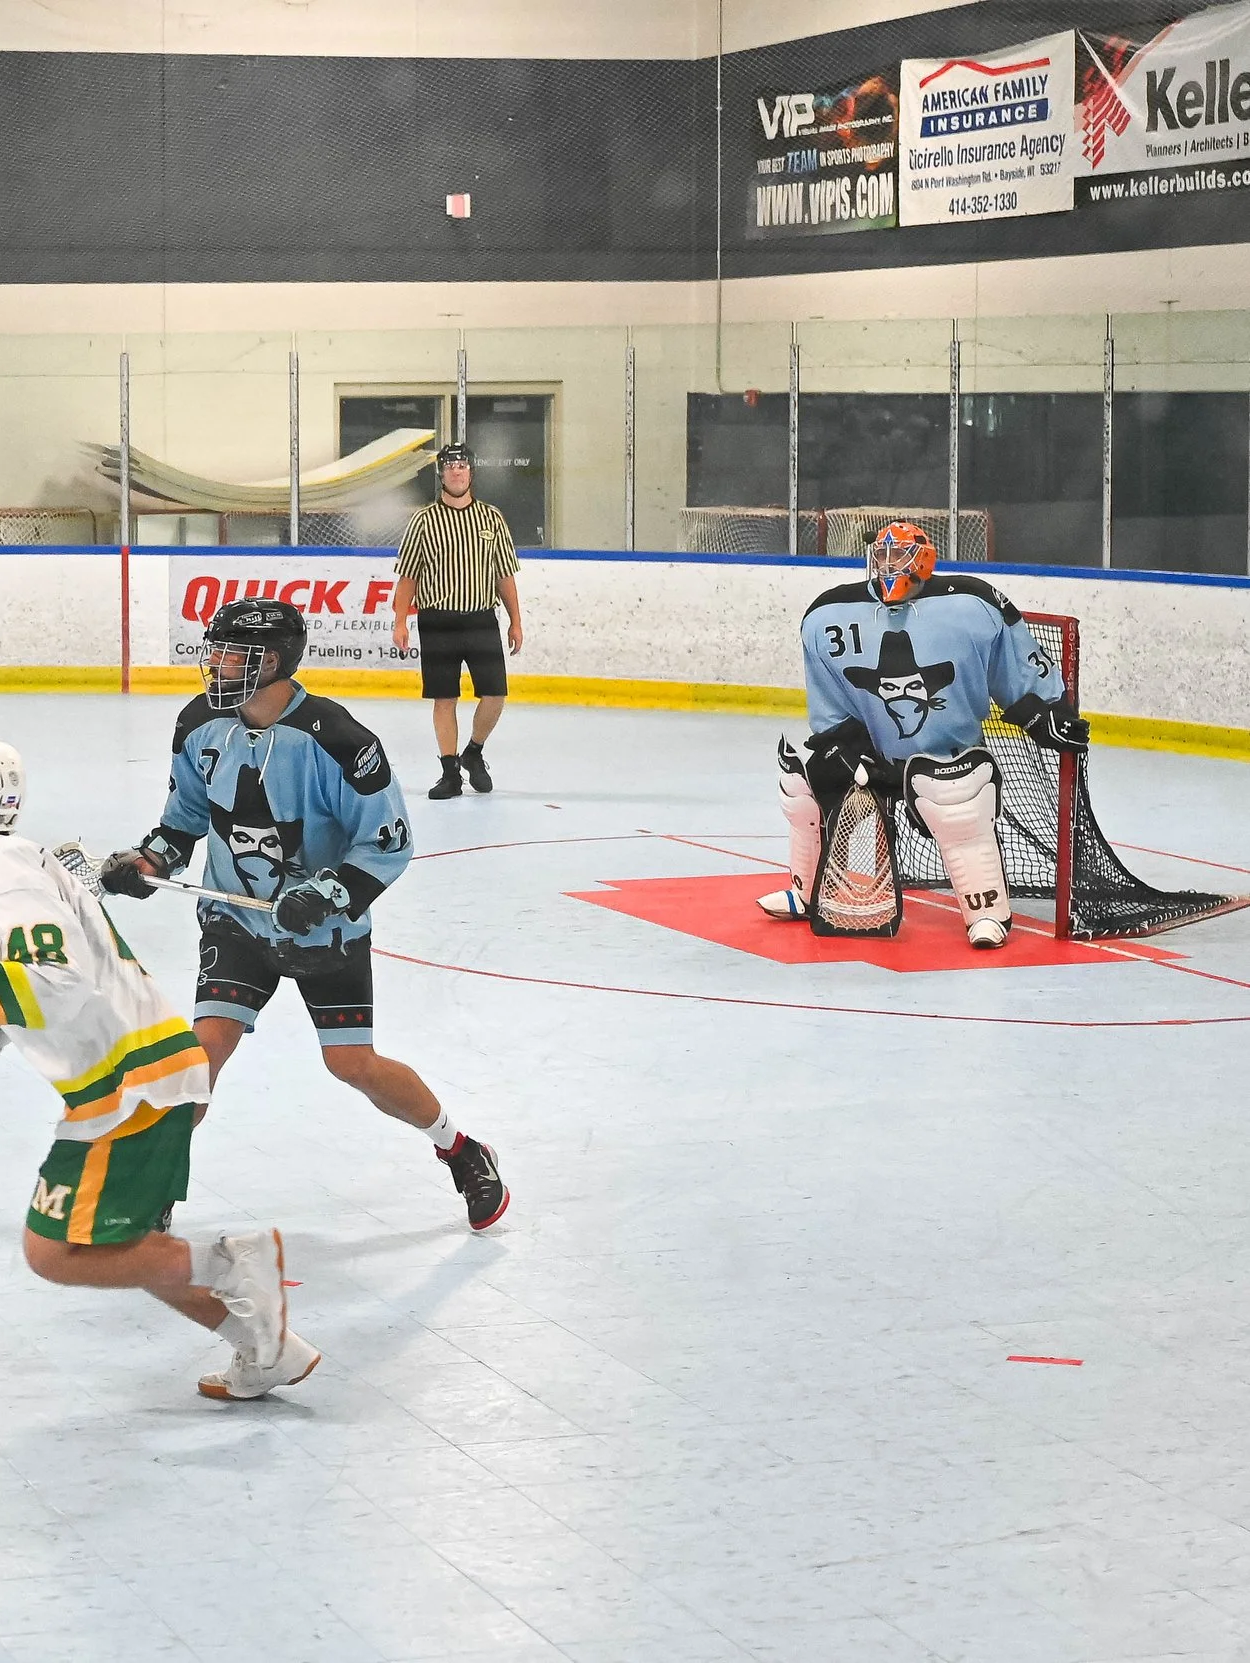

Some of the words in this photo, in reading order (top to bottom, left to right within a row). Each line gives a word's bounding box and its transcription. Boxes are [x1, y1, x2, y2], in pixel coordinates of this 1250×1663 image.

[922, 84, 988, 113] AMERICAN
[995, 74, 1048, 103] FAMILY
[757, 93, 815, 140] VIP
[930, 104, 1037, 133] INSURANCE
[787, 147, 818, 173] TEAM
[827, 147, 851, 166] SPORTS
[957, 141, 1016, 164] Insurance
[1020, 133, 1066, 161] Agency
[1146, 143, 1182, 158] Planners
[1190, 135, 1233, 153] Architects
[930, 176, 945, 188] Port
[945, 172, 981, 188] Washington
[948, 191, 1017, 215] 414-352-1330
[181, 576, 350, 628] QUICK
[309, 645, 362, 660] Fueling
[824, 623, 863, 659] 31
[933, 762, 973, 776] BODDAM
[965, 889, 1000, 911] UP
[7, 924, 68, 964] 48
[32, 1176, 72, 1220] M
